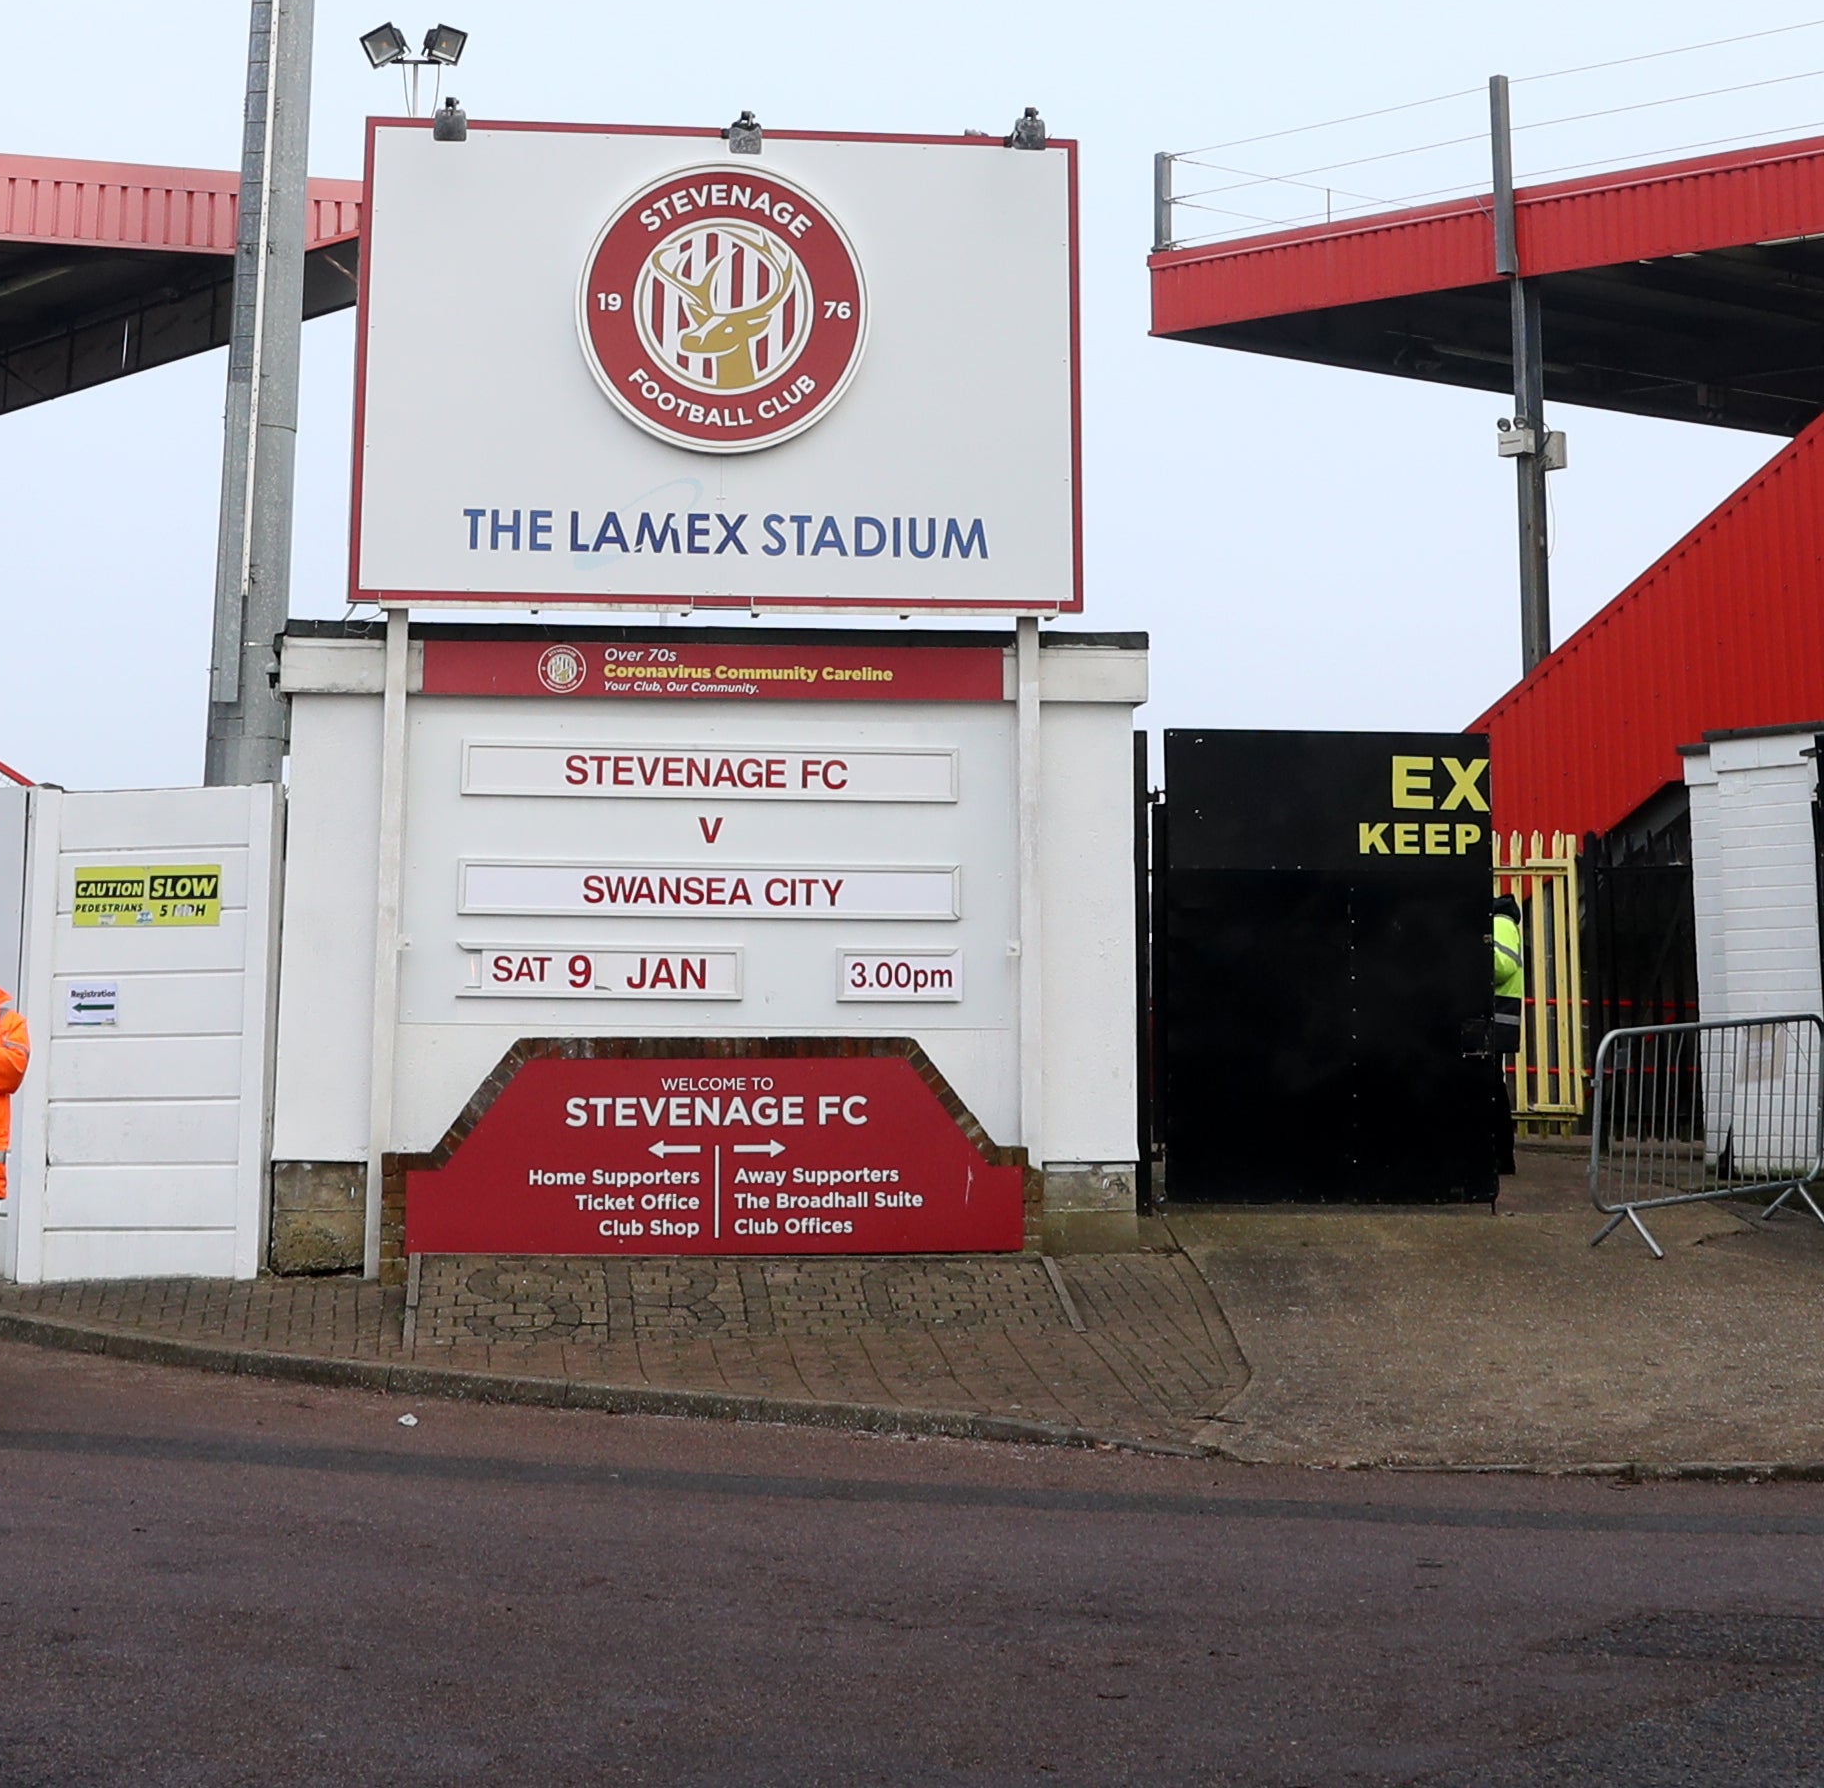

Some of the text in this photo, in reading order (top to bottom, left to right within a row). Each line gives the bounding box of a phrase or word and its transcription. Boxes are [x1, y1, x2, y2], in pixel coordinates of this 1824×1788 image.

[639, 183, 814, 239] STEVENAGE
[596, 292, 852, 320] 19 76
[628, 367, 817, 427] FOOTBALL CLUB
[462, 508, 990, 560] THE LAMEX STADIUM
[604, 648, 677, 663] Over 70s
[603, 664, 894, 683] Coronavirus Community Careline
[604, 681, 760, 695] Your Club, Our Community.
[565, 754, 849, 790] STEVENAGE FC
[1392, 755, 1491, 812] EX
[1358, 822, 1482, 855] KEEP
[77, 882, 143, 897] CAUTION
[151, 877, 217, 898] SLOW
[582, 874, 845, 907] SWANSEA CITY
[75, 903, 143, 913] PEDESTRIANS
[159, 904, 168, 917] 5
[492, 954, 954, 994] SAT 9 JAN 3.00pm
[70, 990, 116, 999] Registration
[661, 1076, 774, 1092] WELCOME TO
[565, 1095, 868, 1127] STEVENAGE FC
[528, 1168, 700, 1188] Home Supporters
[734, 1166, 899, 1187] Away Supporters
[575, 1193, 700, 1210] Ticket Office
[734, 1191, 924, 1209] The Broadhall Suite
[598, 1219, 700, 1239] Club Shop
[734, 1217, 853, 1235] Club Offices
